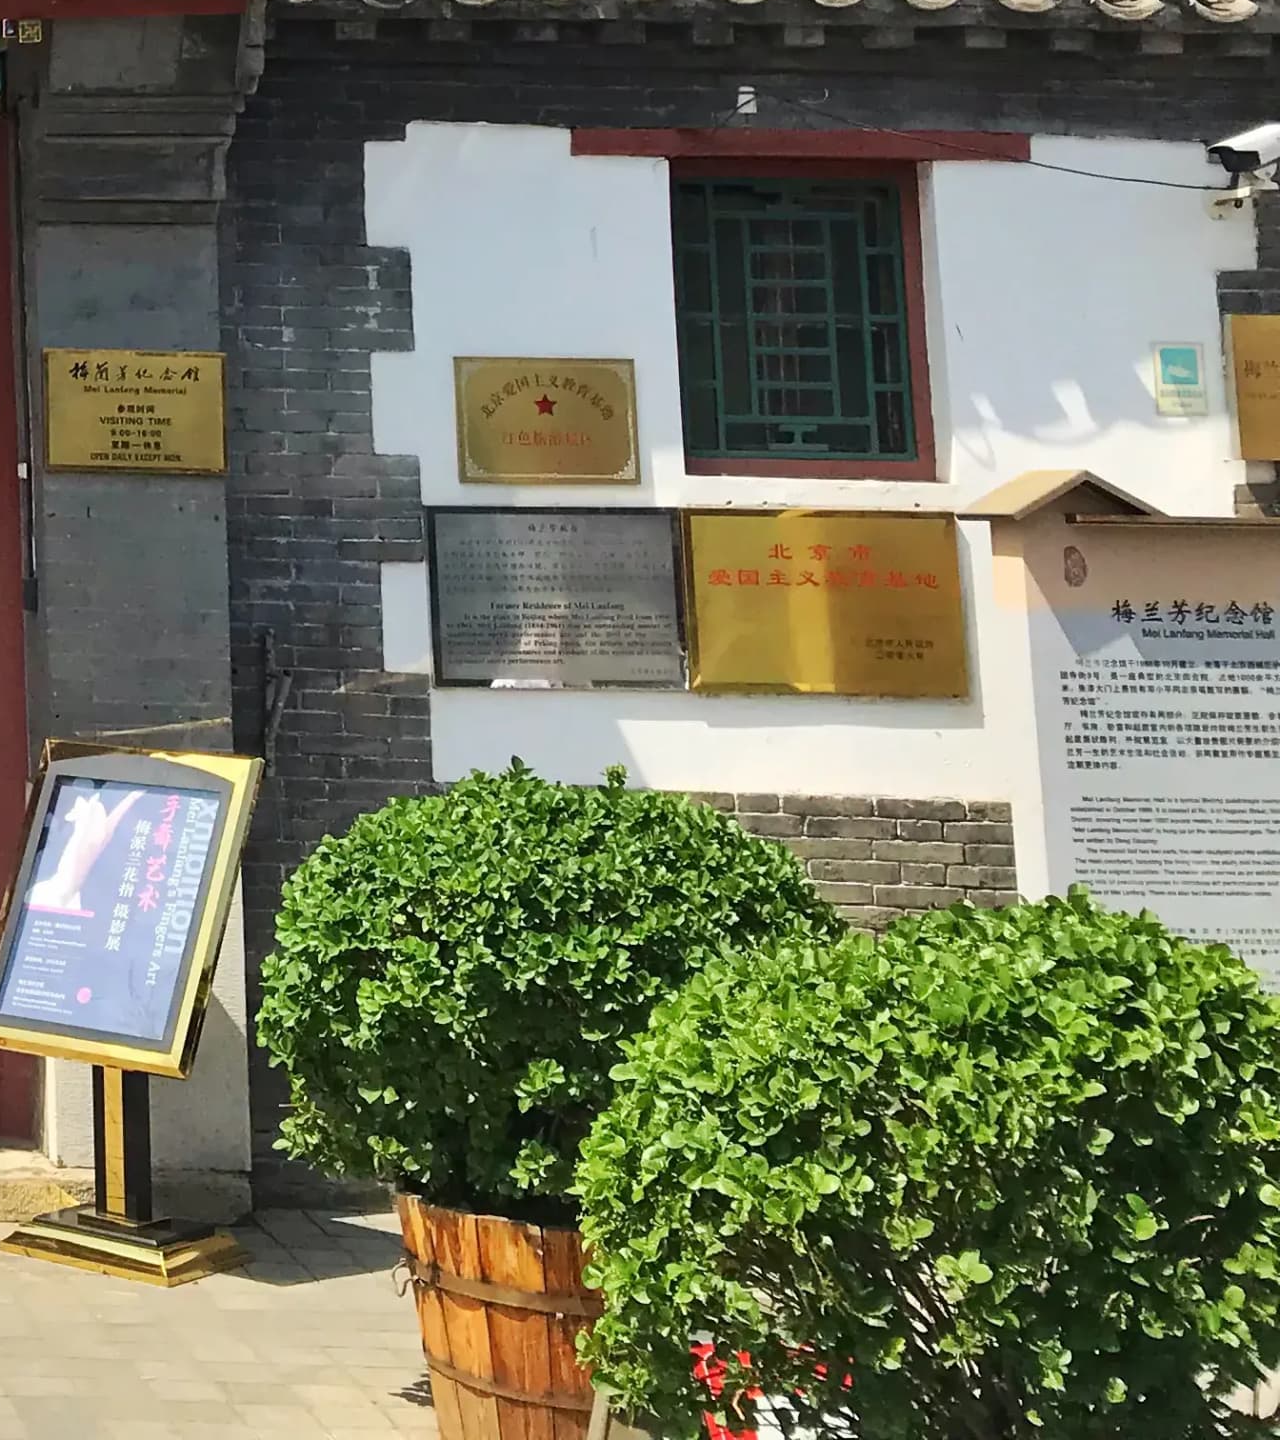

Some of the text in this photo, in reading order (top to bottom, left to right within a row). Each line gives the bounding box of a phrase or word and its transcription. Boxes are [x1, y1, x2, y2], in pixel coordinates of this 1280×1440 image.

[84, 384, 101, 393] Mei
[144, 386, 187, 396] Memorial
[99, 416, 172, 426] VISITING TIME
[90, 452, 109, 461] OPEN
[112, 452, 132, 462] DAILY
[768, 543, 873, 561] 北京市
[708, 568, 940, 590] 爱国主义教育基地
[491, 602, 521, 610] Former
[523, 601, 563, 610] Residence
[574, 602, 590, 610] Mei
[591, 602, 625, 612] Lanfang
[1111, 599, 1275, 626] 梅兰芳纪念馆
[1142, 628, 1276, 641] Mei Lanfang Memorial Hall
[186, 796, 204, 824] Mei
[104, 819, 153, 952] 梅派兰花指 摄影展
[151, 902, 177, 958] Fingers
[144, 962, 161, 987] Art
